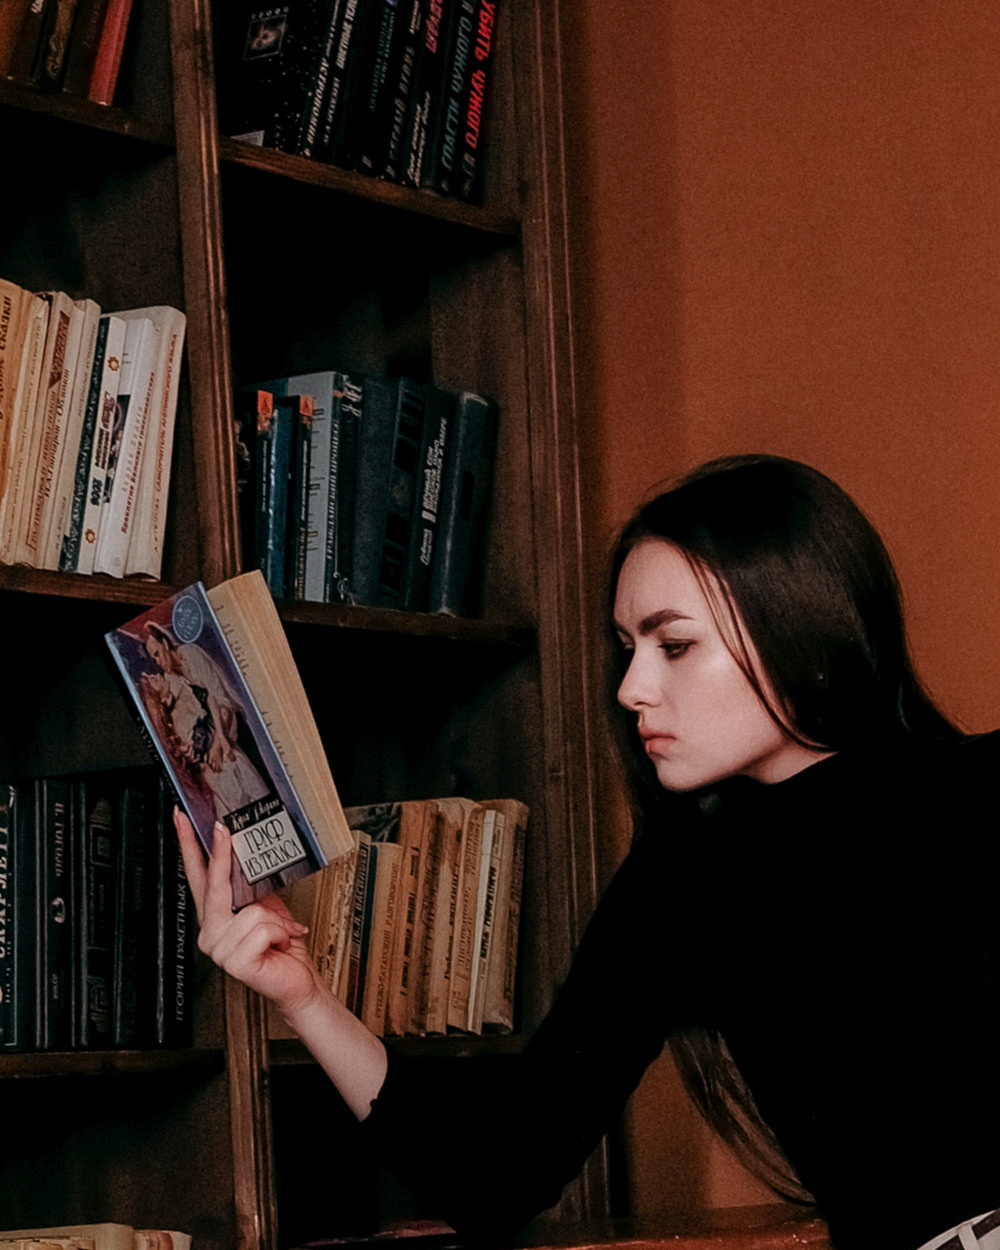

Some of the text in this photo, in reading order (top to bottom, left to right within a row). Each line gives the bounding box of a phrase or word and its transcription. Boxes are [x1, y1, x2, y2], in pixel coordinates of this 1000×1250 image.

[439, 15, 474, 170] СПАСТИ ЧУЖОГО
[463, 0, 496, 149] УБИТЬ ЧУЖОГО
[54, 822, 64, 876] ГОГОЛЬ
[242, 816, 287, 855] ГРАФ
[243, 836, 302, 878] ИЗ ТЕХАСА
[174, 884, 186, 958] РАКЕТНЫХ
[175, 965, 185, 1021] ТЕОРИЯ
